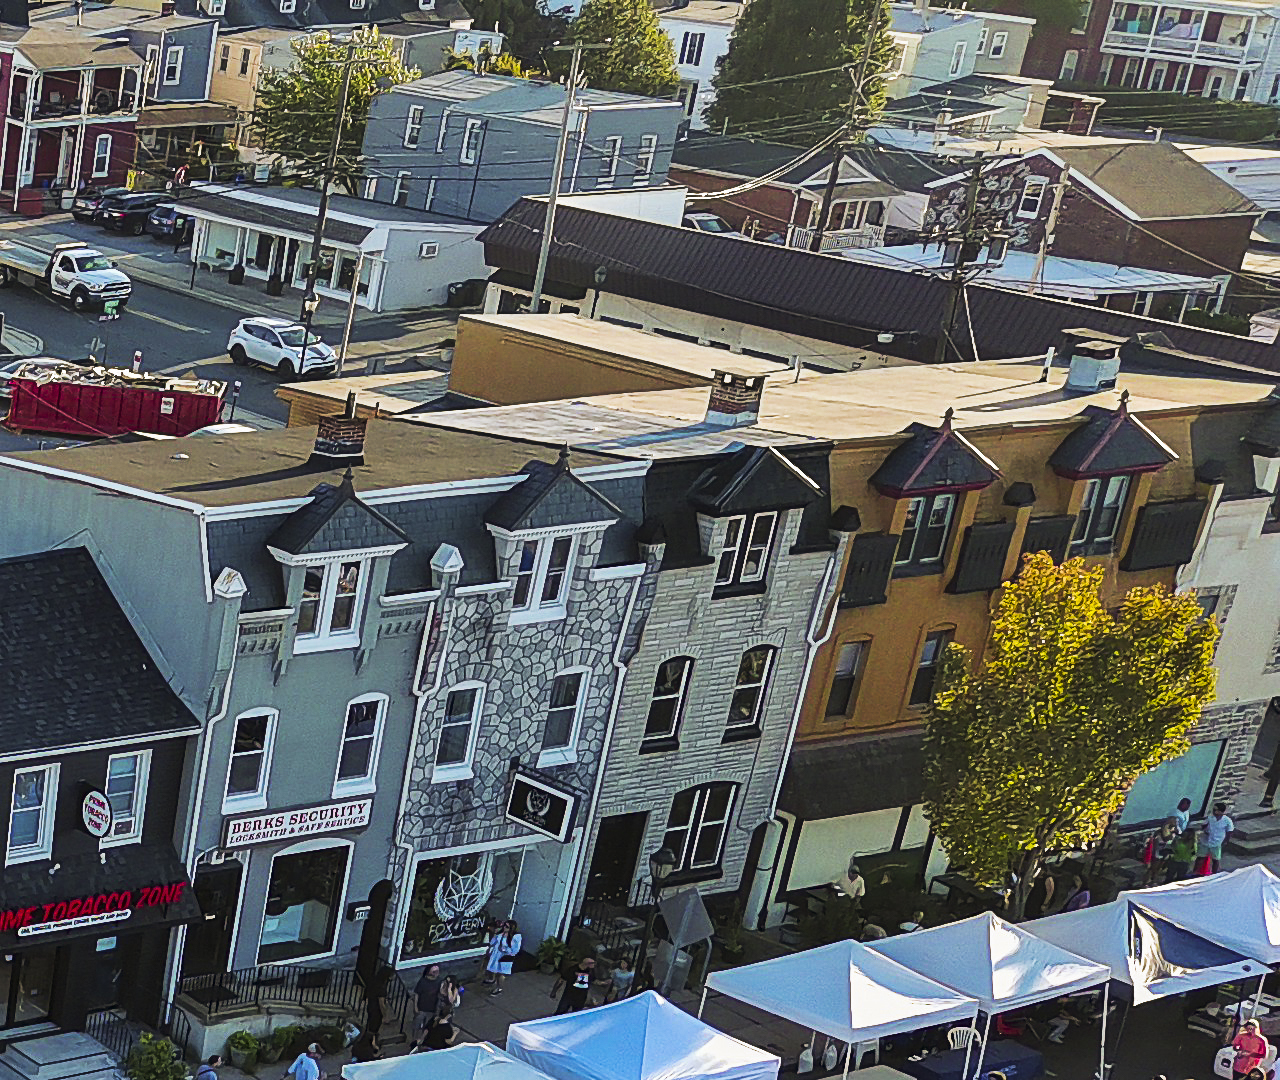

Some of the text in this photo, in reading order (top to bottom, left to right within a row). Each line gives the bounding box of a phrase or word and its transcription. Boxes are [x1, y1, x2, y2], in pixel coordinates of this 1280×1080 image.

[289, 803, 367, 825] SECURITY
[230, 828, 286, 844] LOCKSMITH
[42, 891, 131, 922] TOBACCO
[136, 881, 187, 909] ZONE
[429, 922, 452, 938] FOX
